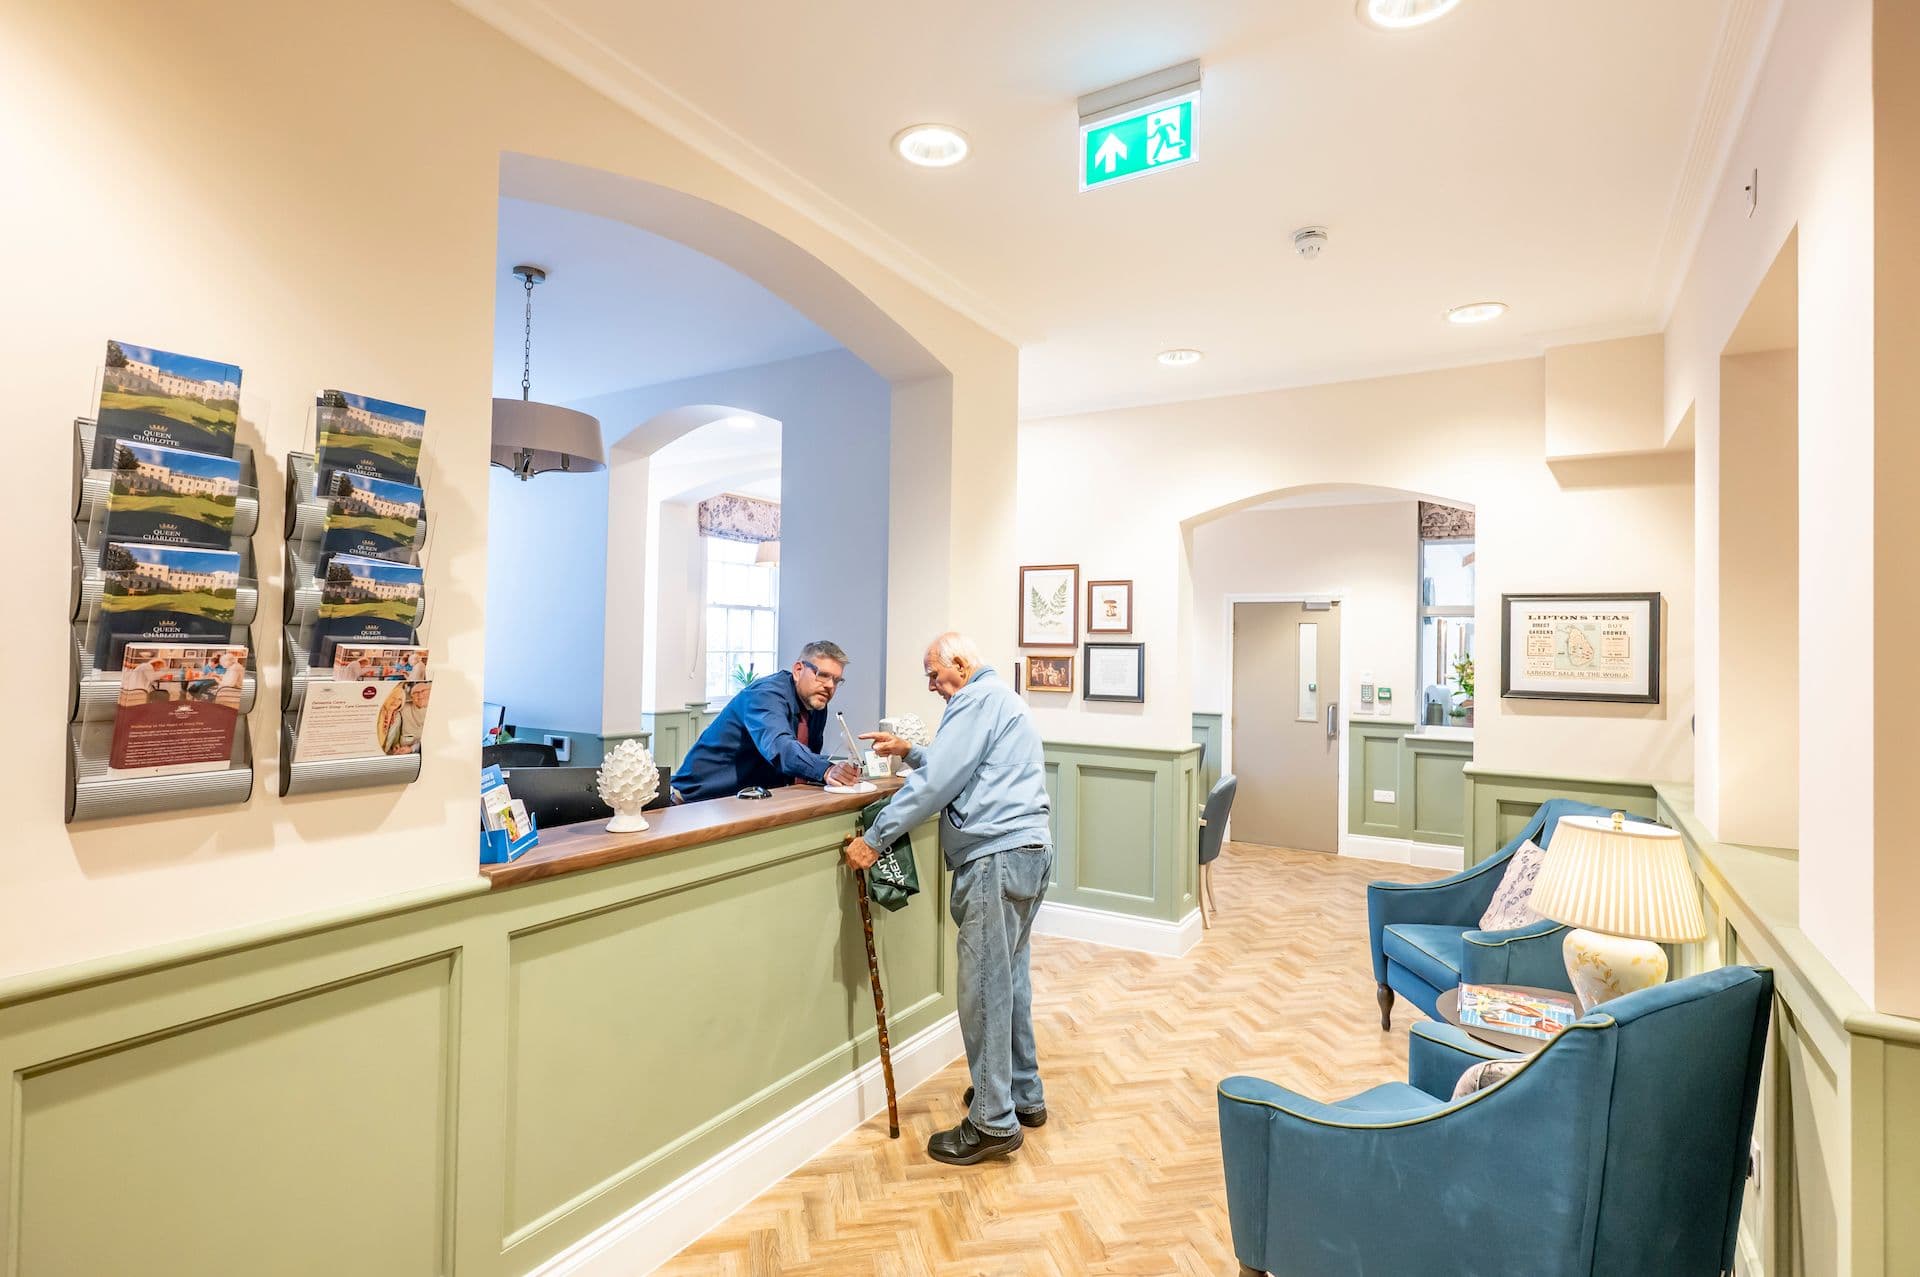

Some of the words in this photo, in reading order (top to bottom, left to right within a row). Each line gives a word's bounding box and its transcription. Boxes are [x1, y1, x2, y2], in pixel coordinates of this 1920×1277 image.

[143, 430, 171, 439] QUEEN
[133, 434, 179, 446] CHARLOTTE
[348, 468, 382, 477] CHARLOTTE
[143, 534, 188, 543] CHARLOTTE
